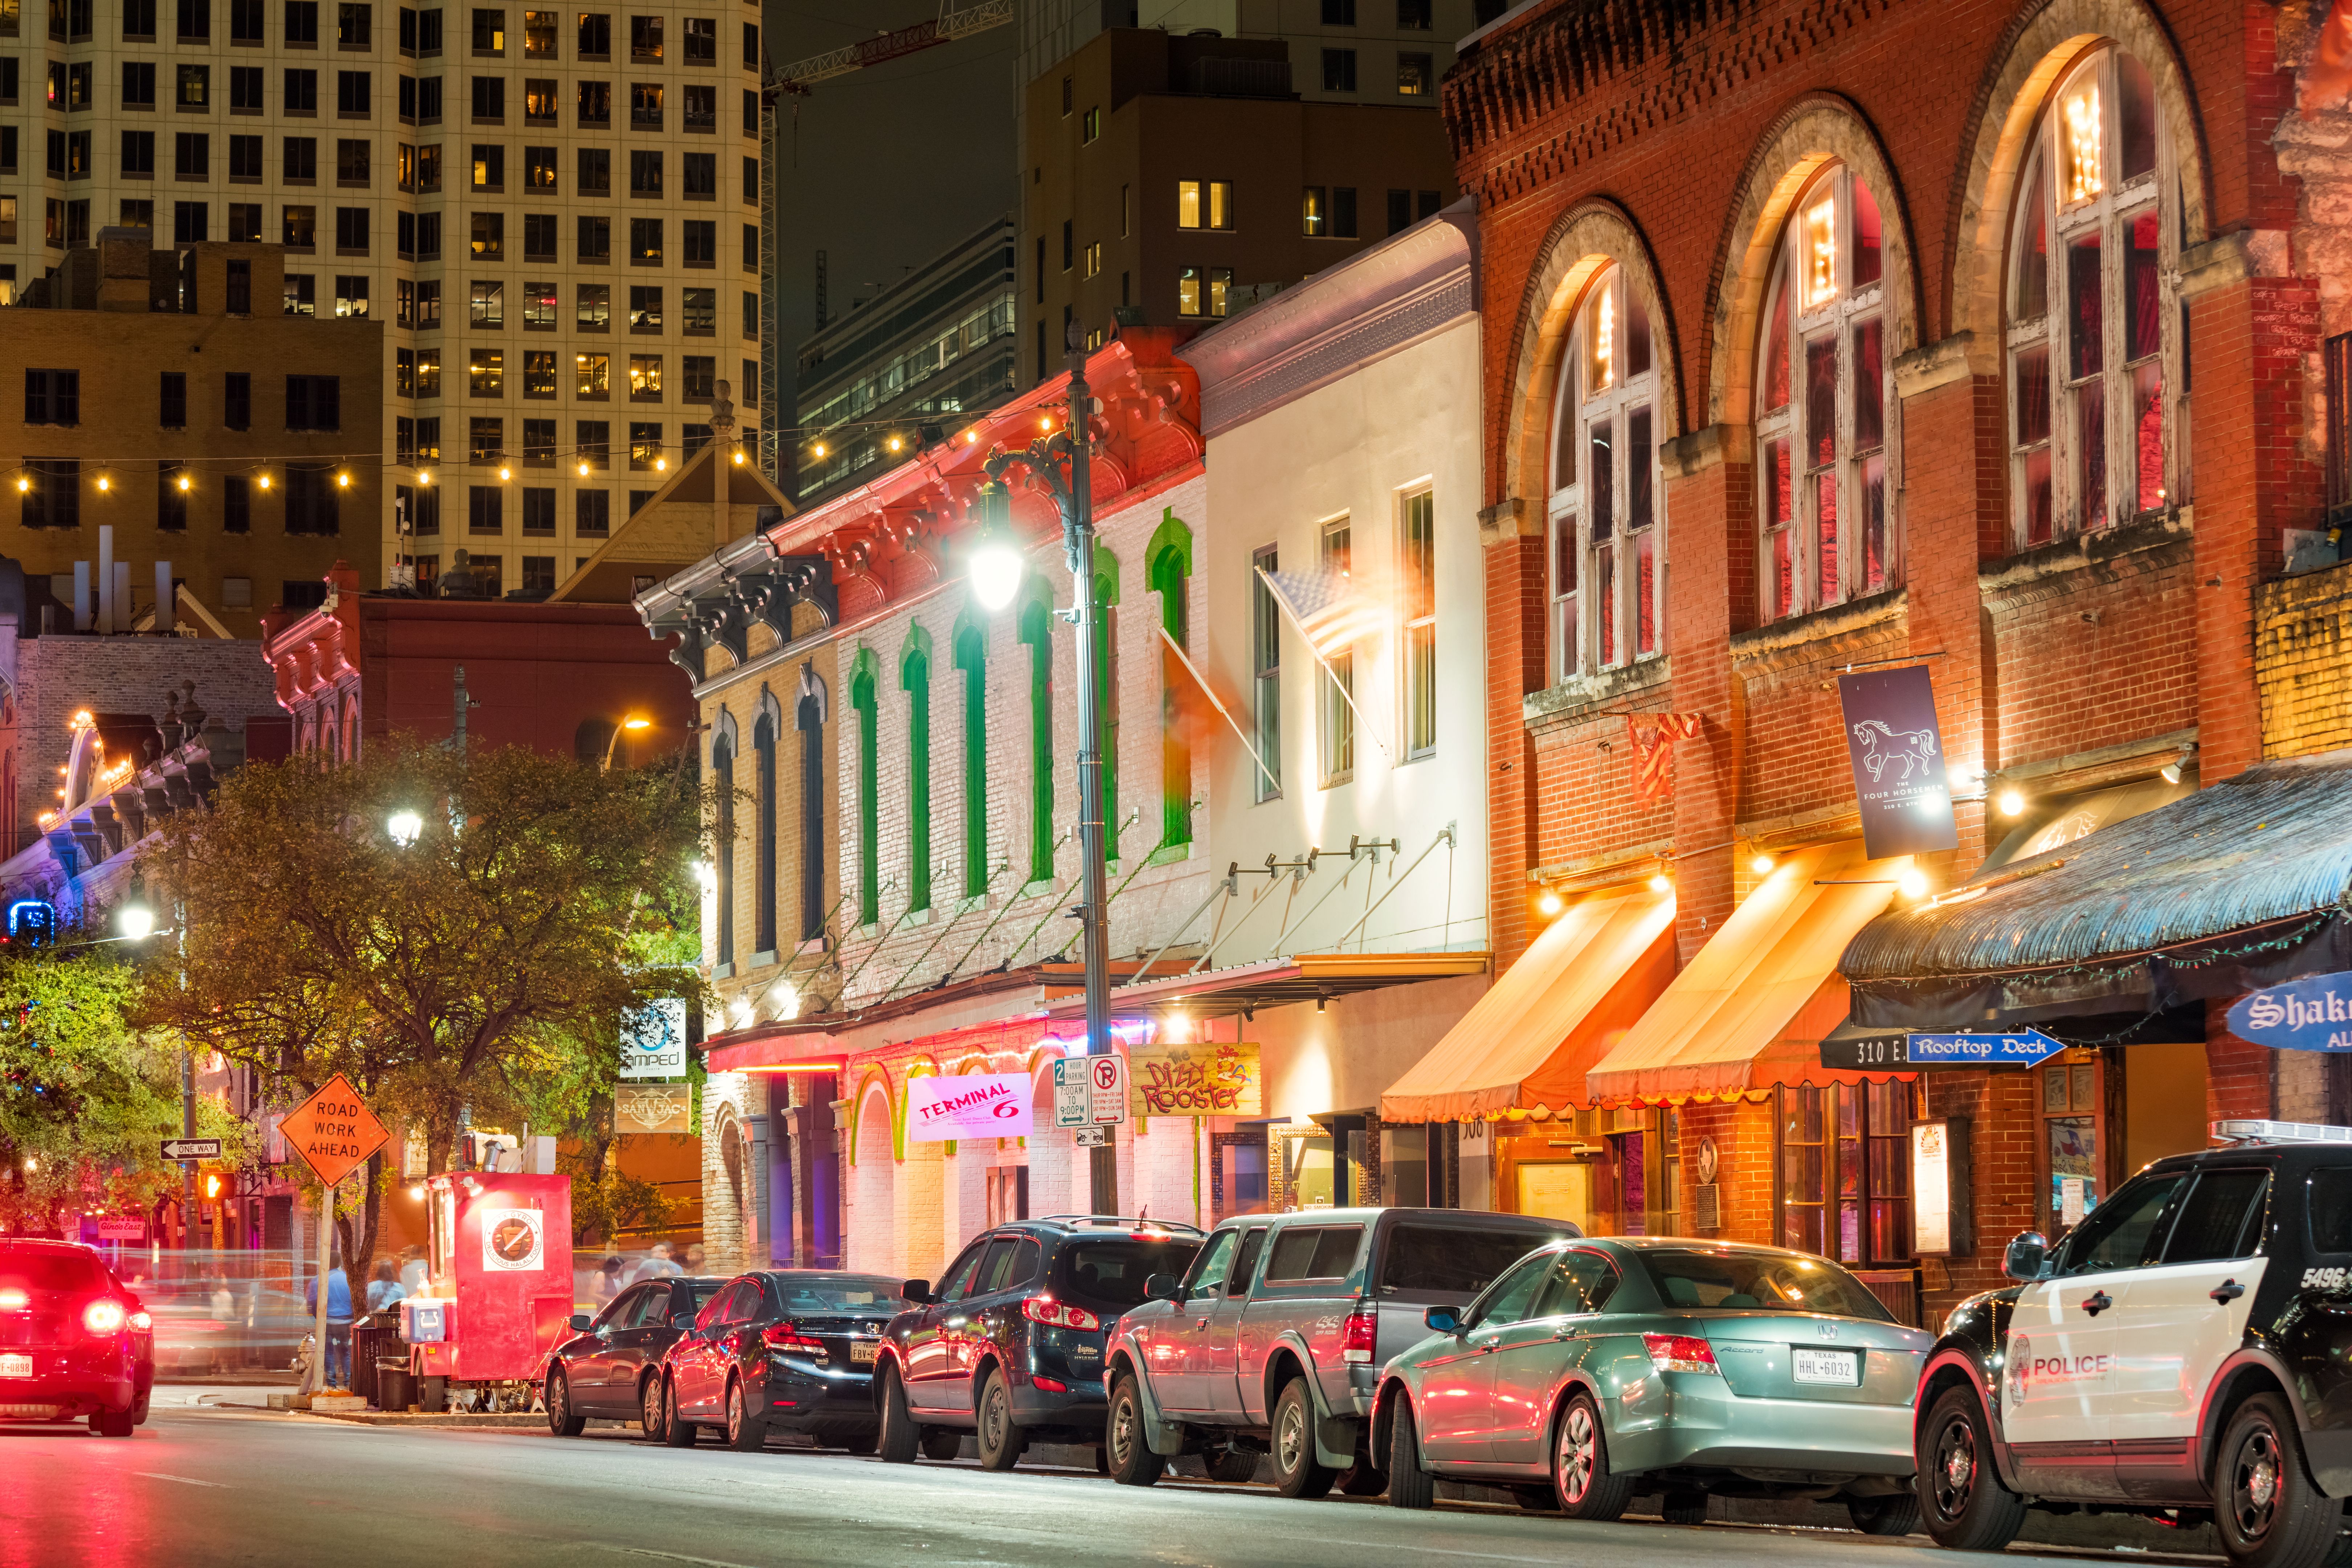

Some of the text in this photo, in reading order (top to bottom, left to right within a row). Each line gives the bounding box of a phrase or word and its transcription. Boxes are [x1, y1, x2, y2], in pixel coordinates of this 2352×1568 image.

[1864, 784, 1943, 800] FOUR HORSEMEN
[2249, 990, 2352, 1032] Shak
[1915, 1038, 2047, 1057] Rooftop Deck
[2327, 1031, 2352, 1048] AL
[1858, 1040, 1906, 1064] 310 E.
[1056, 1063, 1064, 1082] 2
[1066, 1071, 1085, 1081] PARKING
[1060, 1085, 1083, 1096] 7:00AM
[919, 1083, 1010, 1119] TERMINAL
[993, 1099, 1019, 1118] 6
[1068, 1096, 1076, 1105] TO
[317, 1102, 358, 1117] ROAD
[622, 1104, 681, 1114] SAN JAC
[1060, 1105, 1084, 1115] 9:00PM
[315, 1122, 356, 1138] WORK
[308, 1142, 359, 1157] AHEAD
[511, 1212, 532, 1224] GYRO
[486, 1241, 540, 1267] DELICIOUS HALAL FOOD
[2300, 1267, 2346, 1288] 5496
[2034, 1355, 2108, 1376] POLICE
